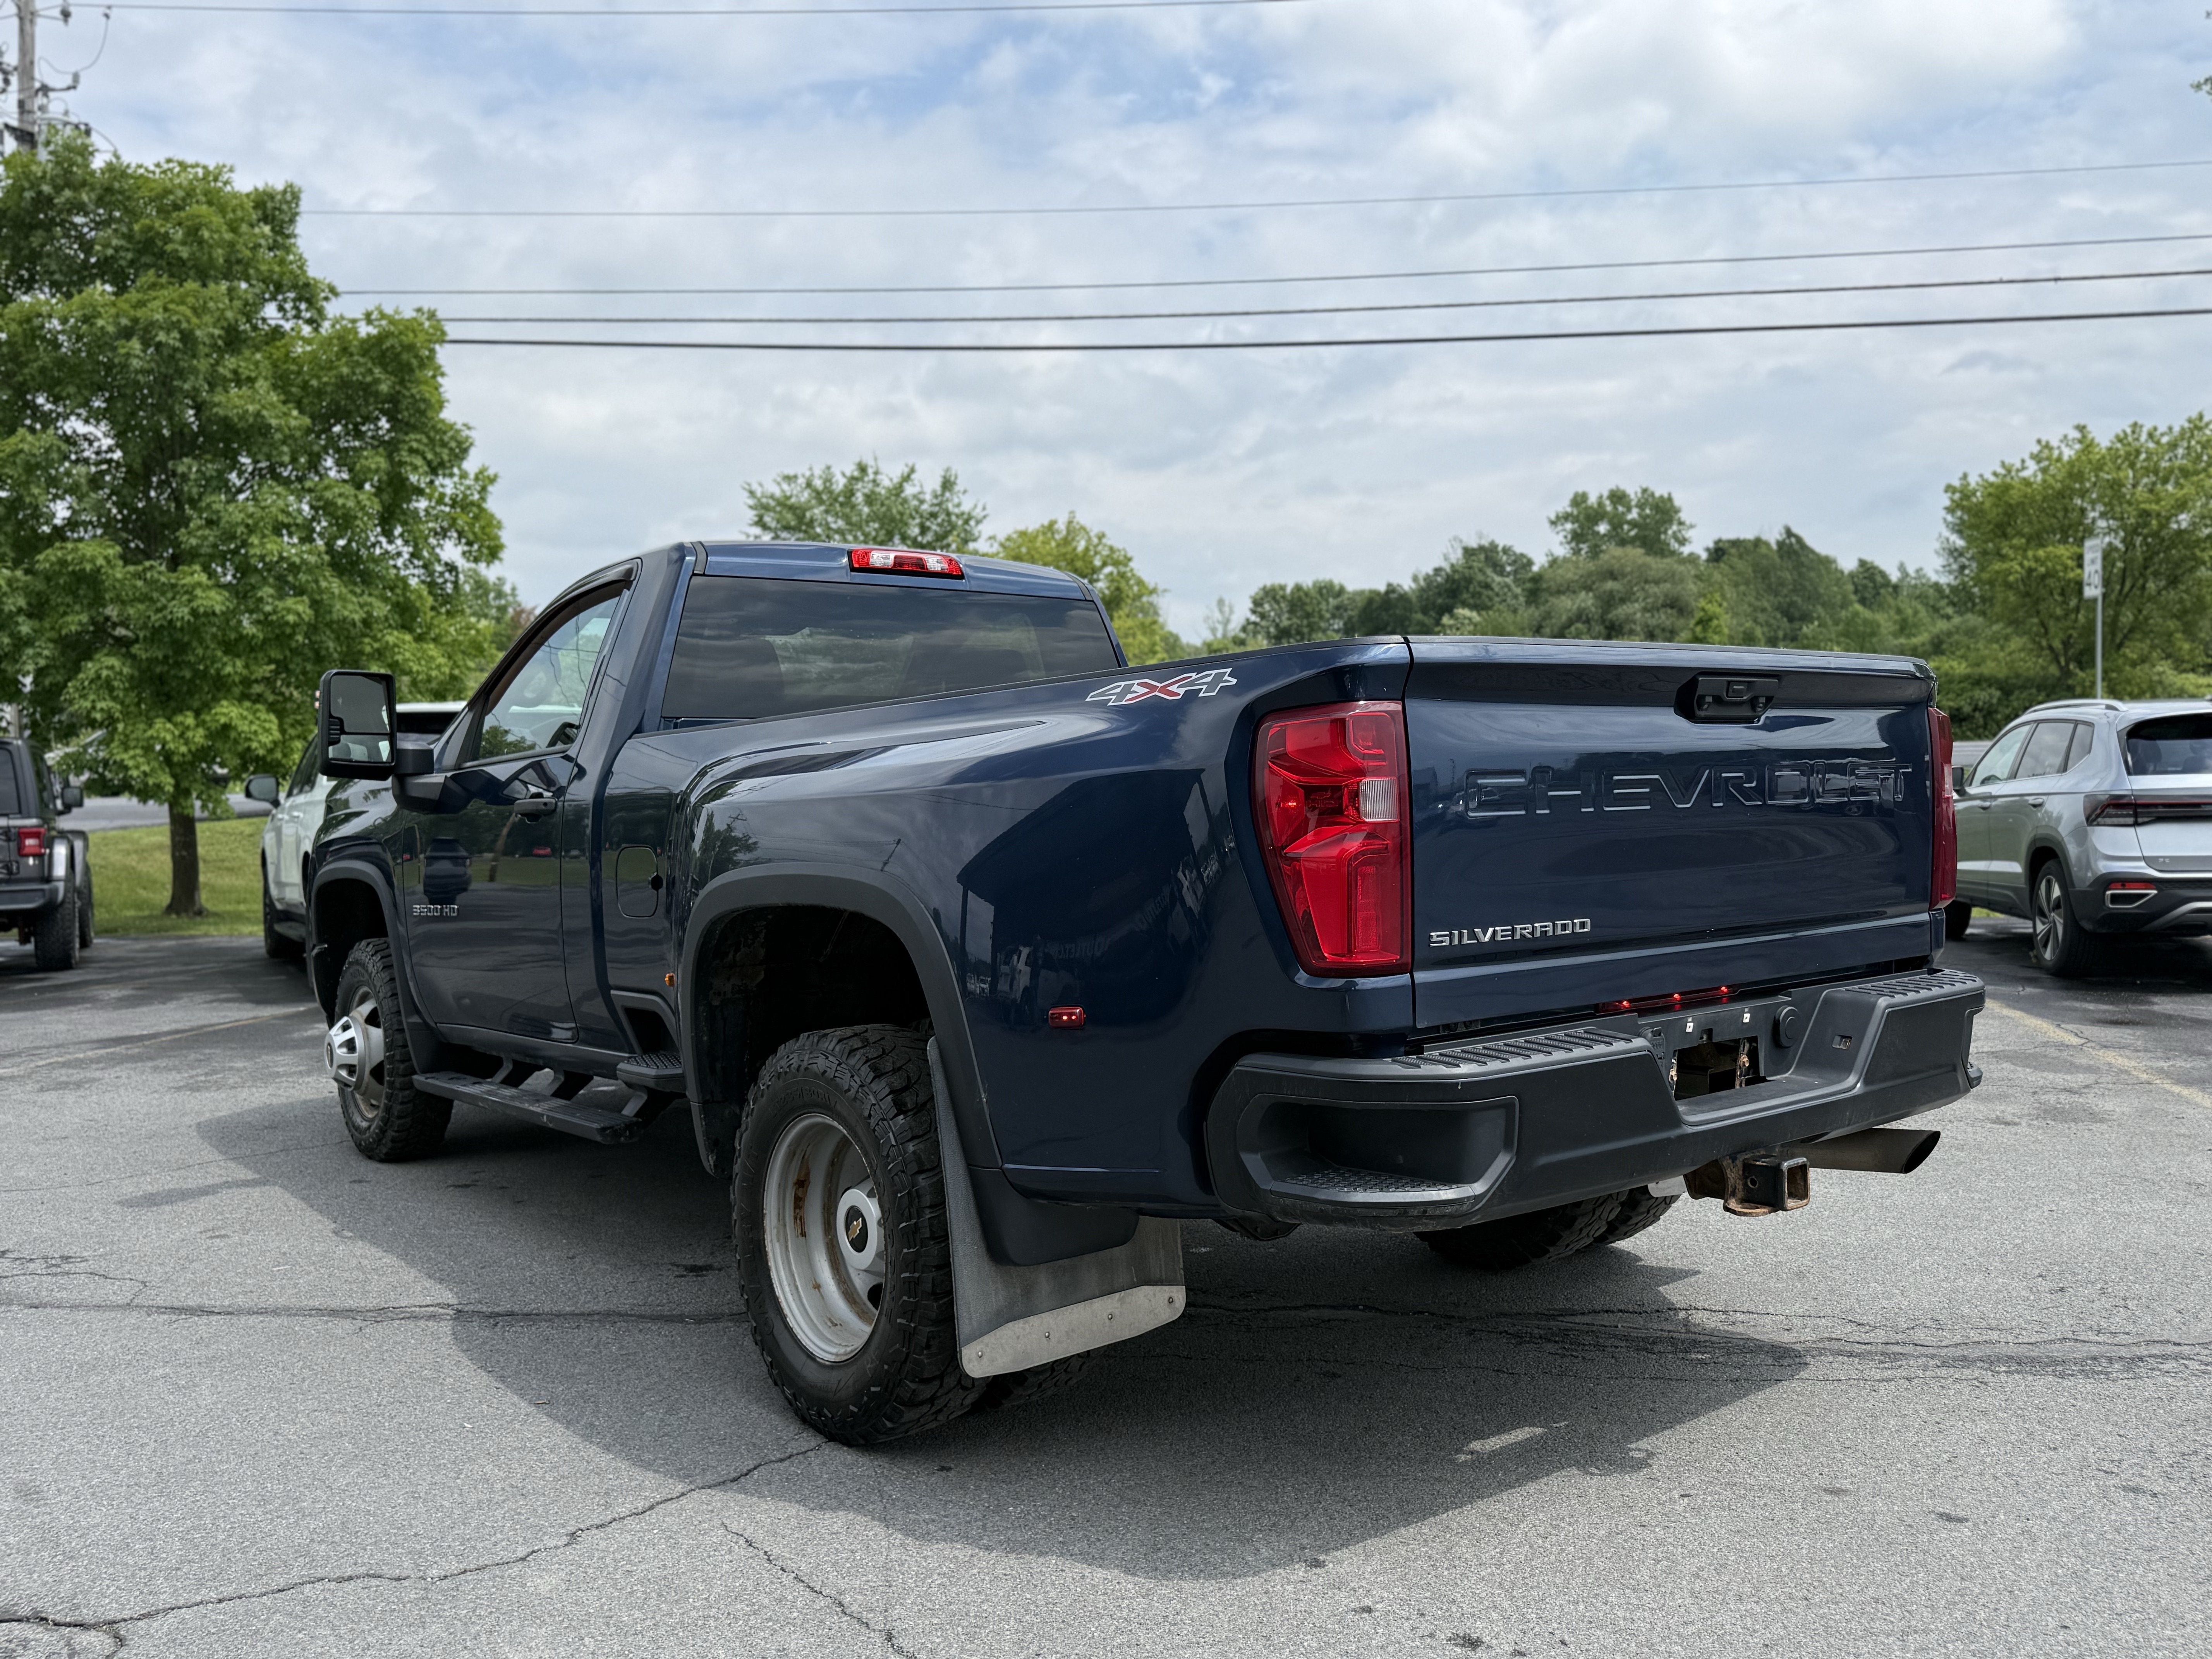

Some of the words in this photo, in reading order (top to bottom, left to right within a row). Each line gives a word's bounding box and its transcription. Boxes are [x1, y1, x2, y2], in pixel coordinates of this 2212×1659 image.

[2085, 568, 2099, 590] 40
[1465, 762, 1912, 818] CHEVROLET
[413, 905, 441, 916] 3500
[443, 905, 459, 916] HD
[1429, 918, 1591, 947] SILVERADO
